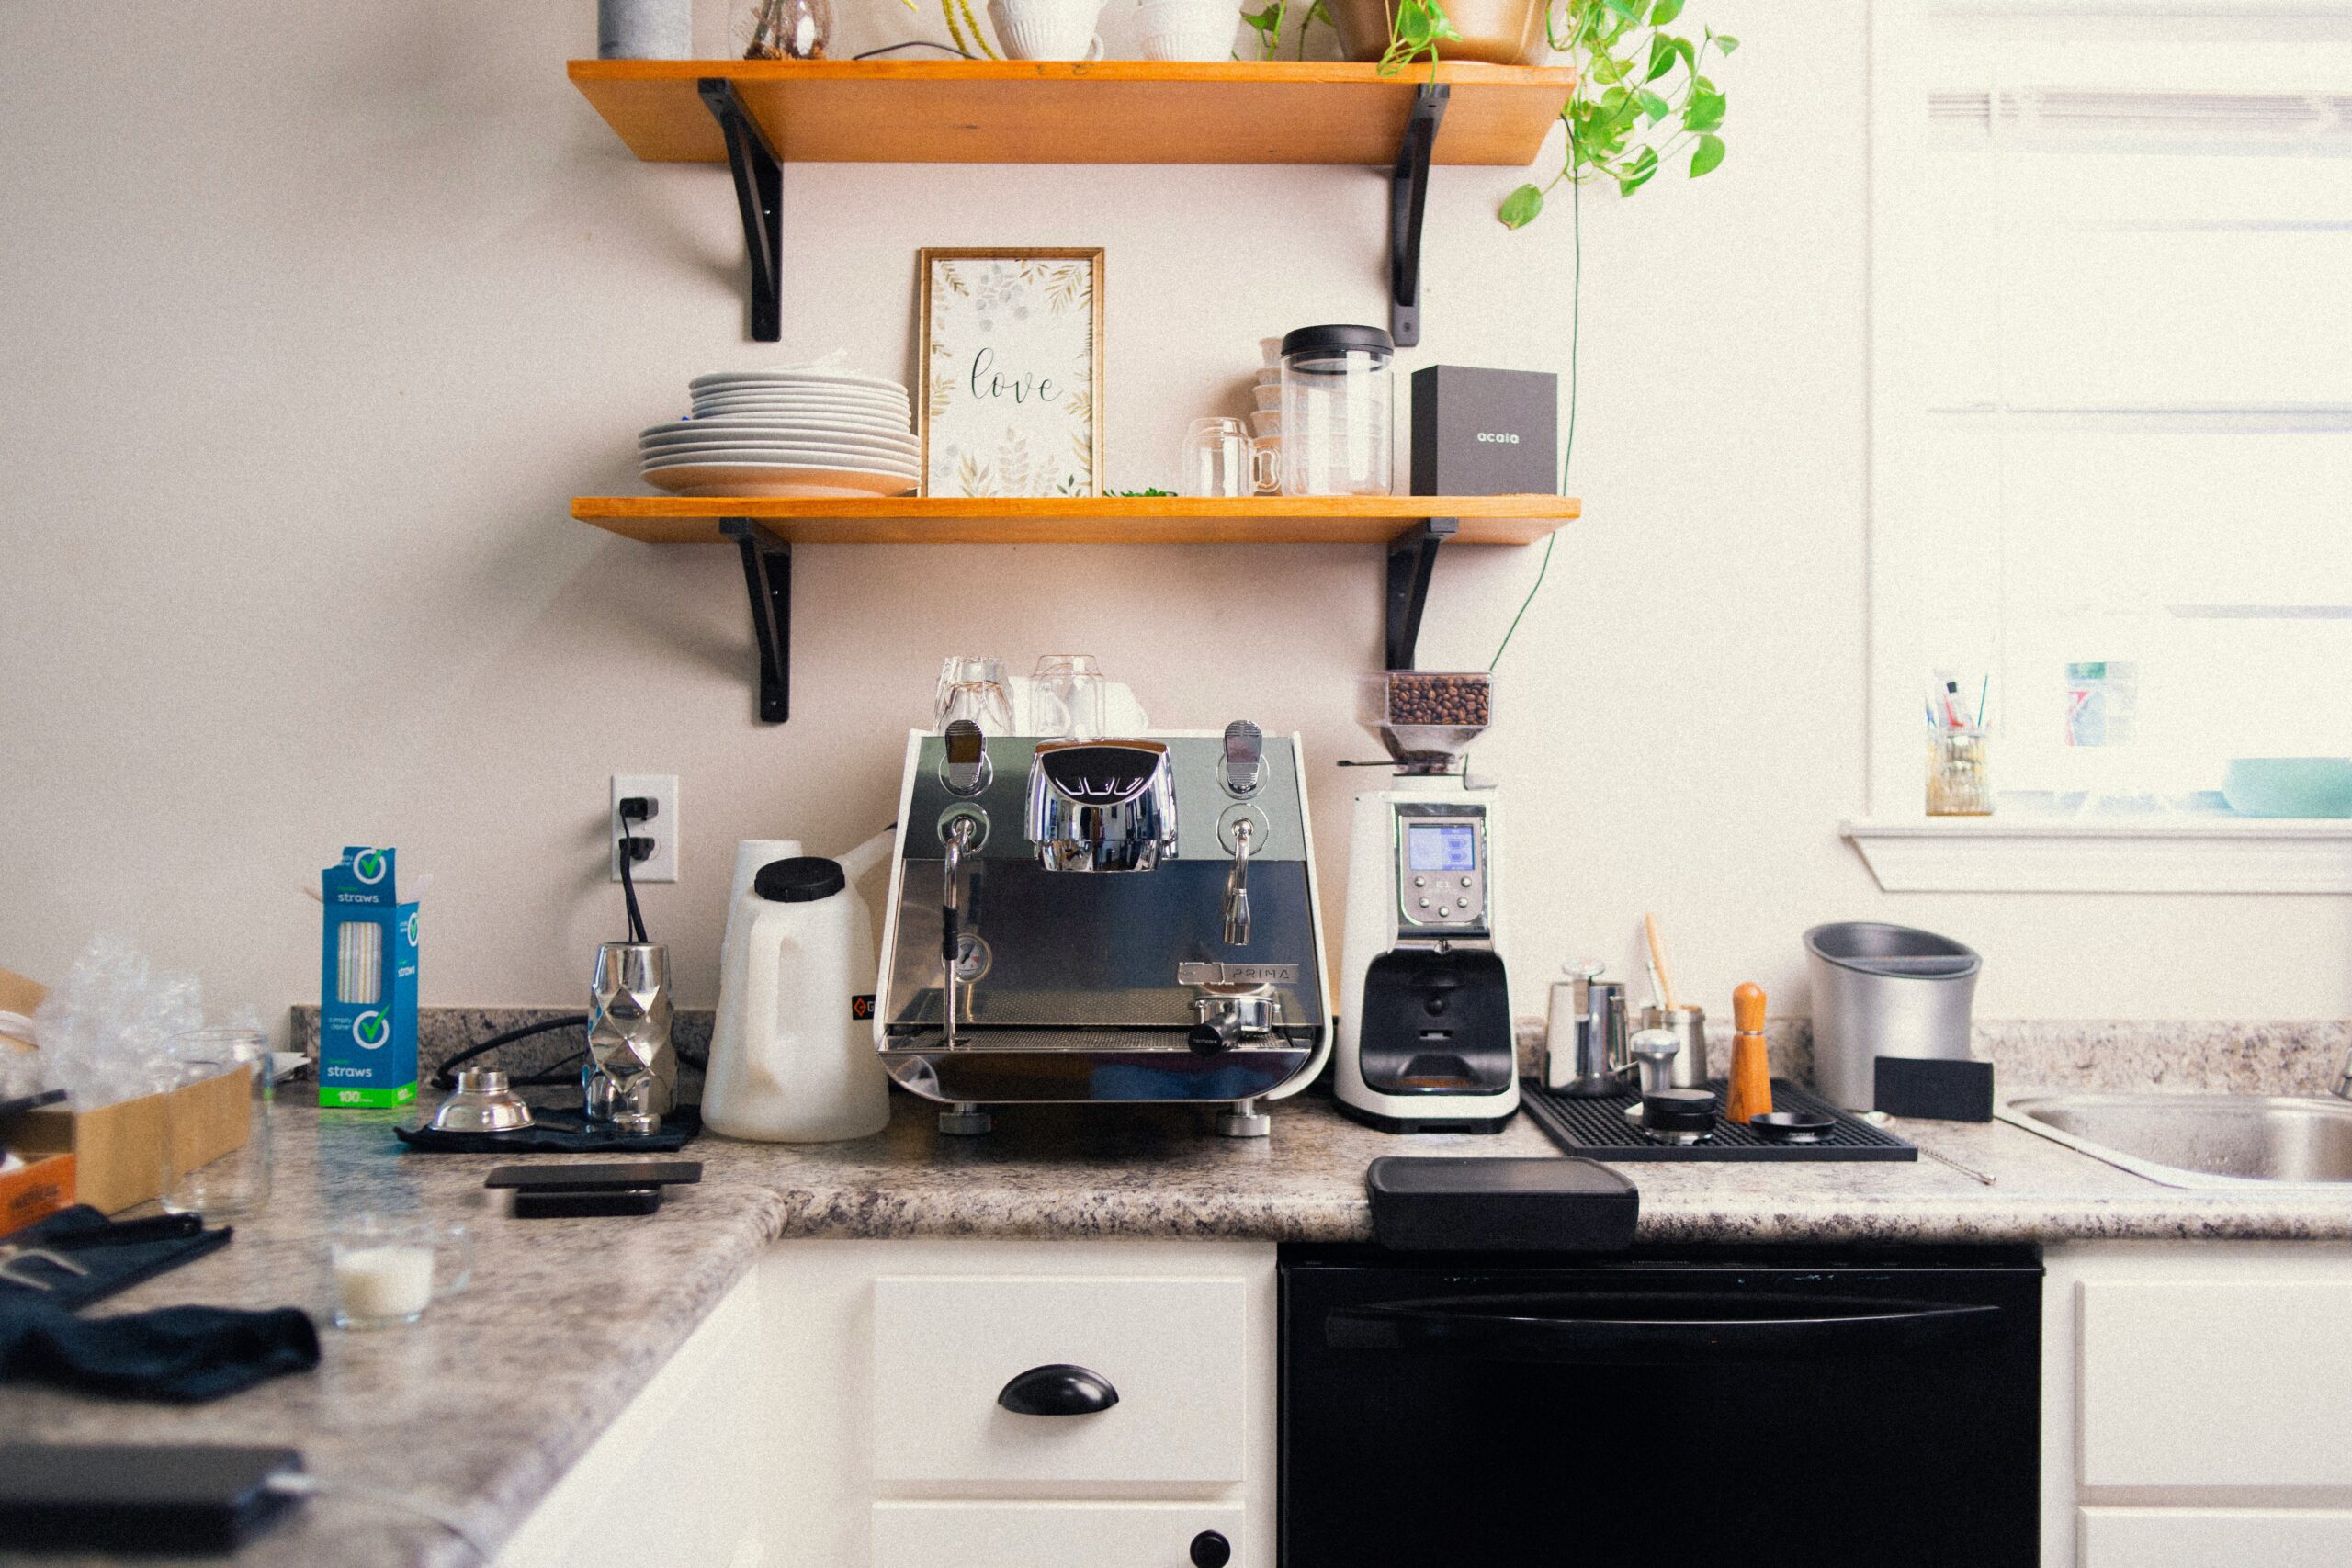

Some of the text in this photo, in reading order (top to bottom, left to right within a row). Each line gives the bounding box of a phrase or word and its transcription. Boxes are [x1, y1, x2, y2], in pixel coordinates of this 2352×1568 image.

[971, 347, 1063, 404] love
[1477, 432, 1520, 444] acaia
[337, 892, 379, 904] straws
[1232, 967, 1291, 979] PRIMA
[327, 1065, 372, 1078] straws
[338, 1090, 361, 1103] 100
